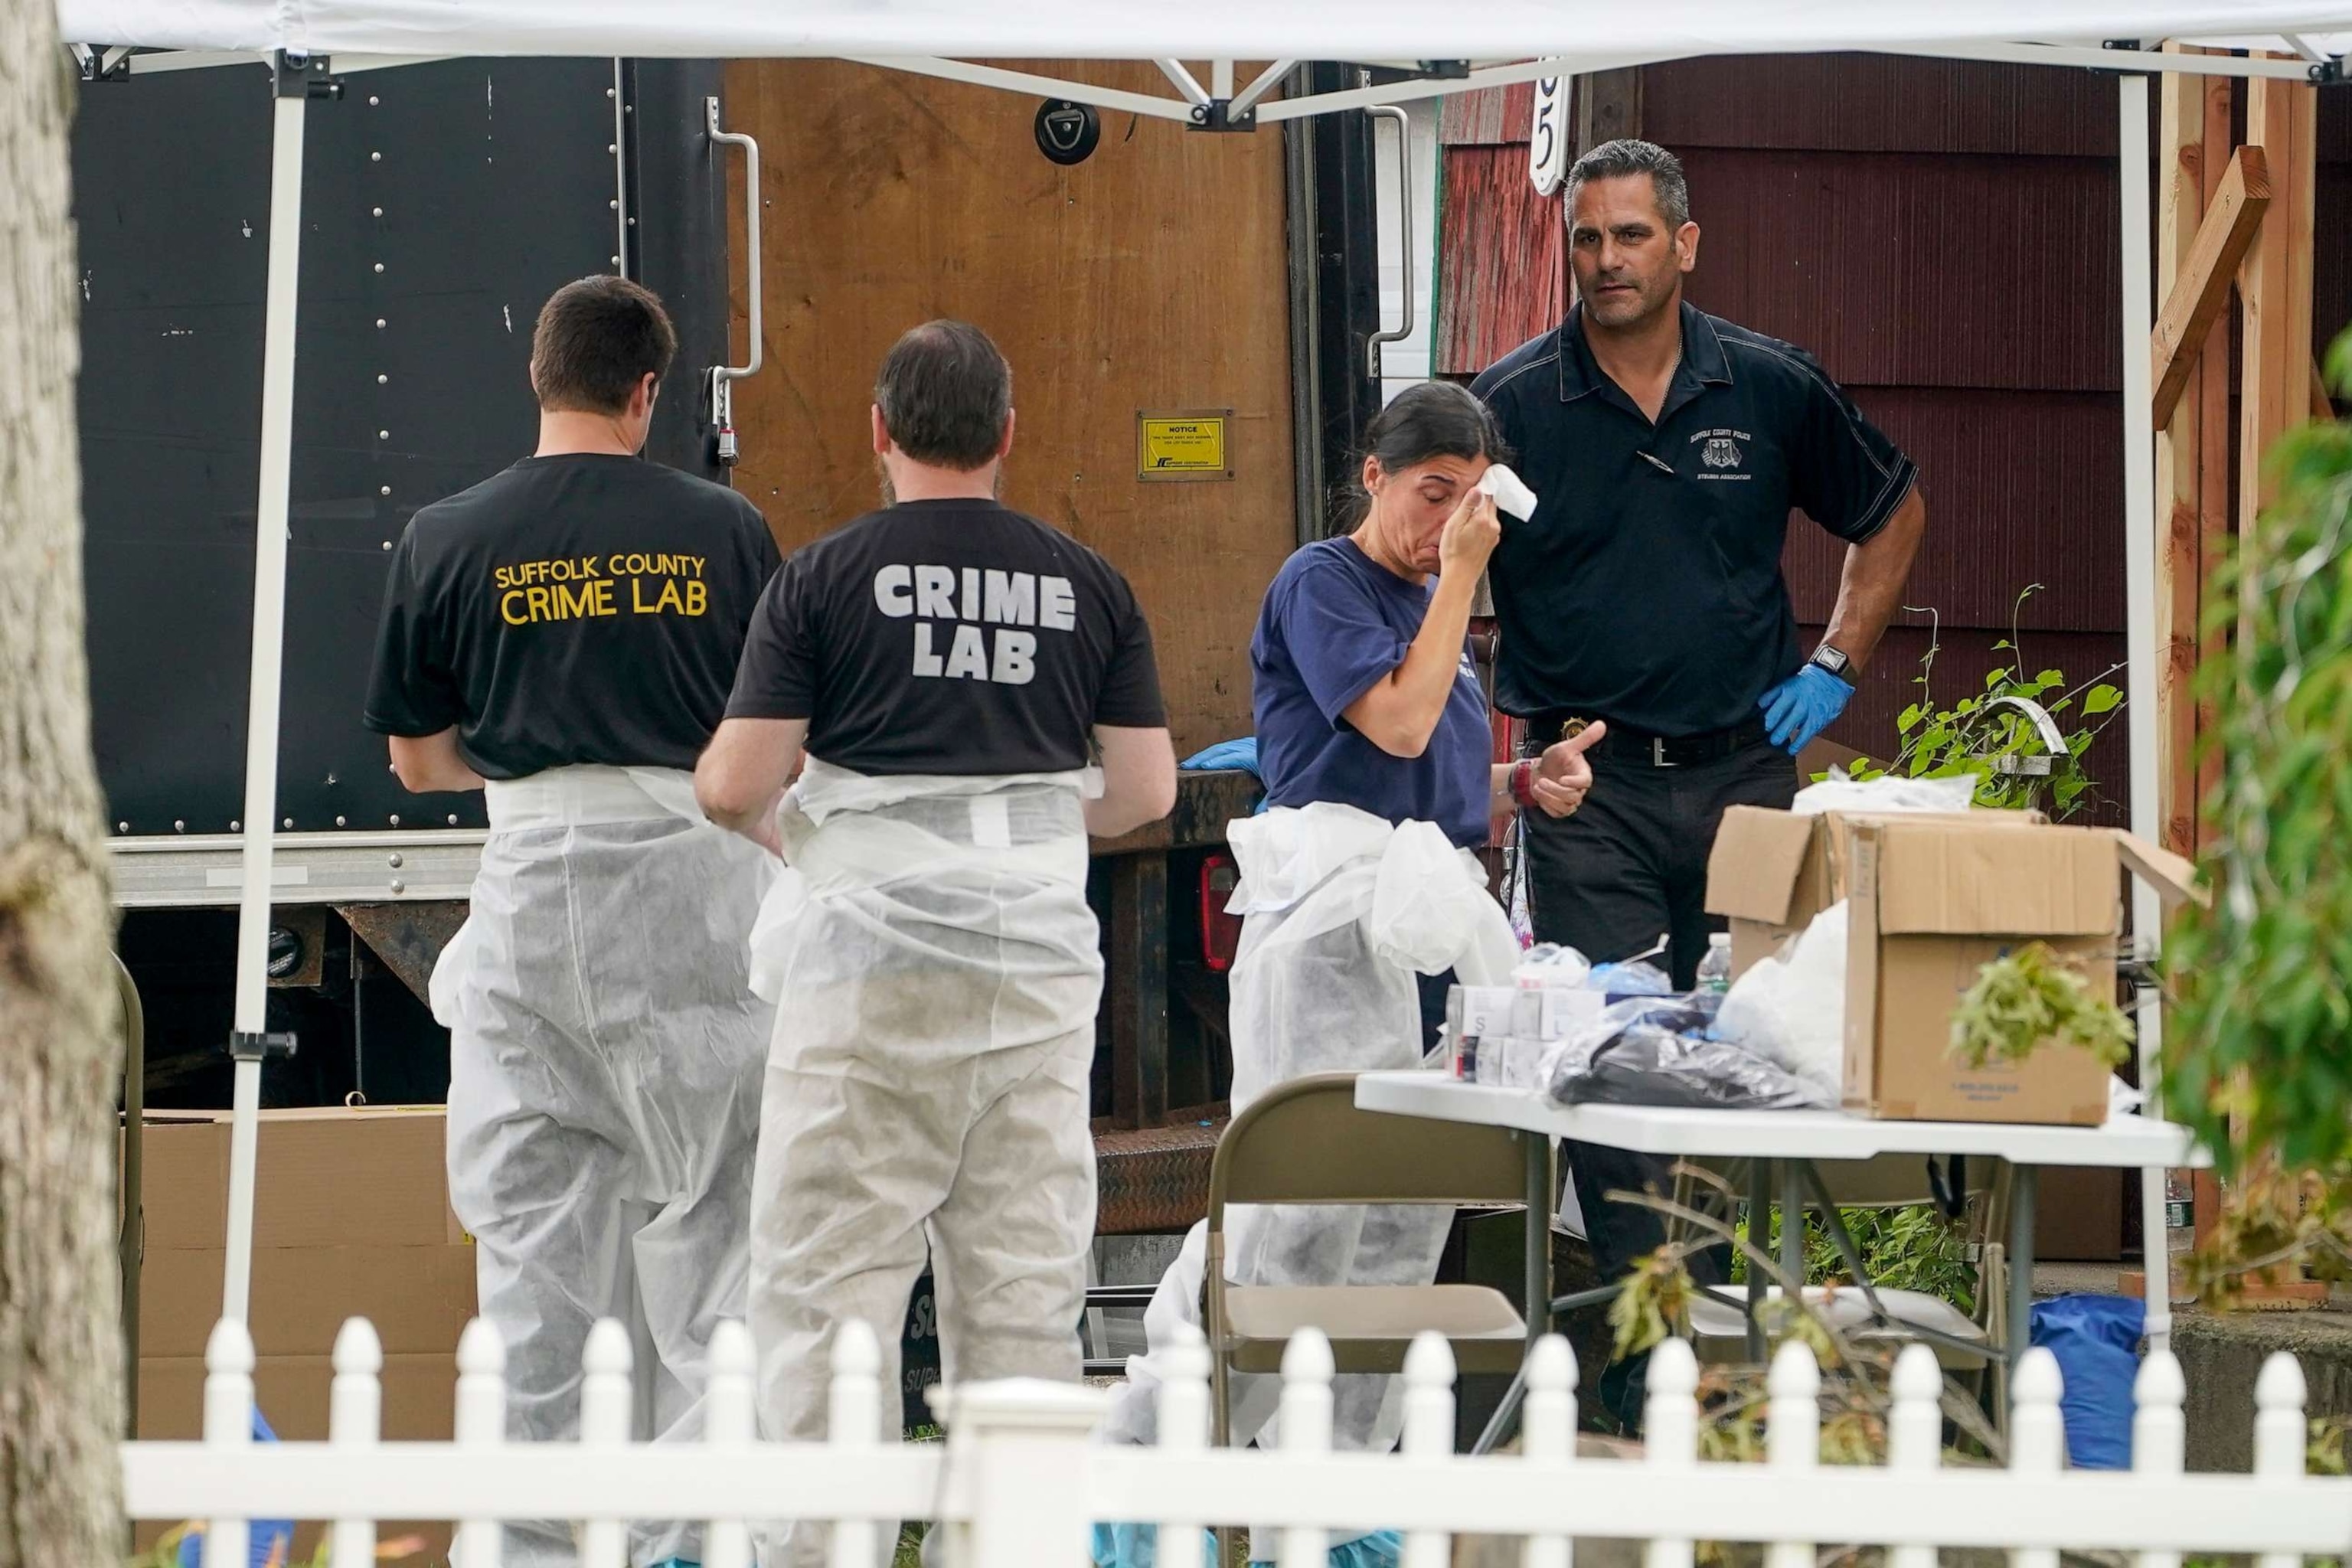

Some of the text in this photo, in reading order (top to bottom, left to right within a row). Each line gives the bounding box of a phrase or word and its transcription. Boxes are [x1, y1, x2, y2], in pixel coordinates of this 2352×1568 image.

[1690, 430, 1710, 443] SUFFOLK
[1733, 430, 1751, 441] POLICE
[495, 554, 705, 589] SUFFOLK COUNTY
[501, 577, 707, 626] CRIME LAB
[874, 564, 1076, 632] CRIME
[912, 622, 1037, 685] LAB
